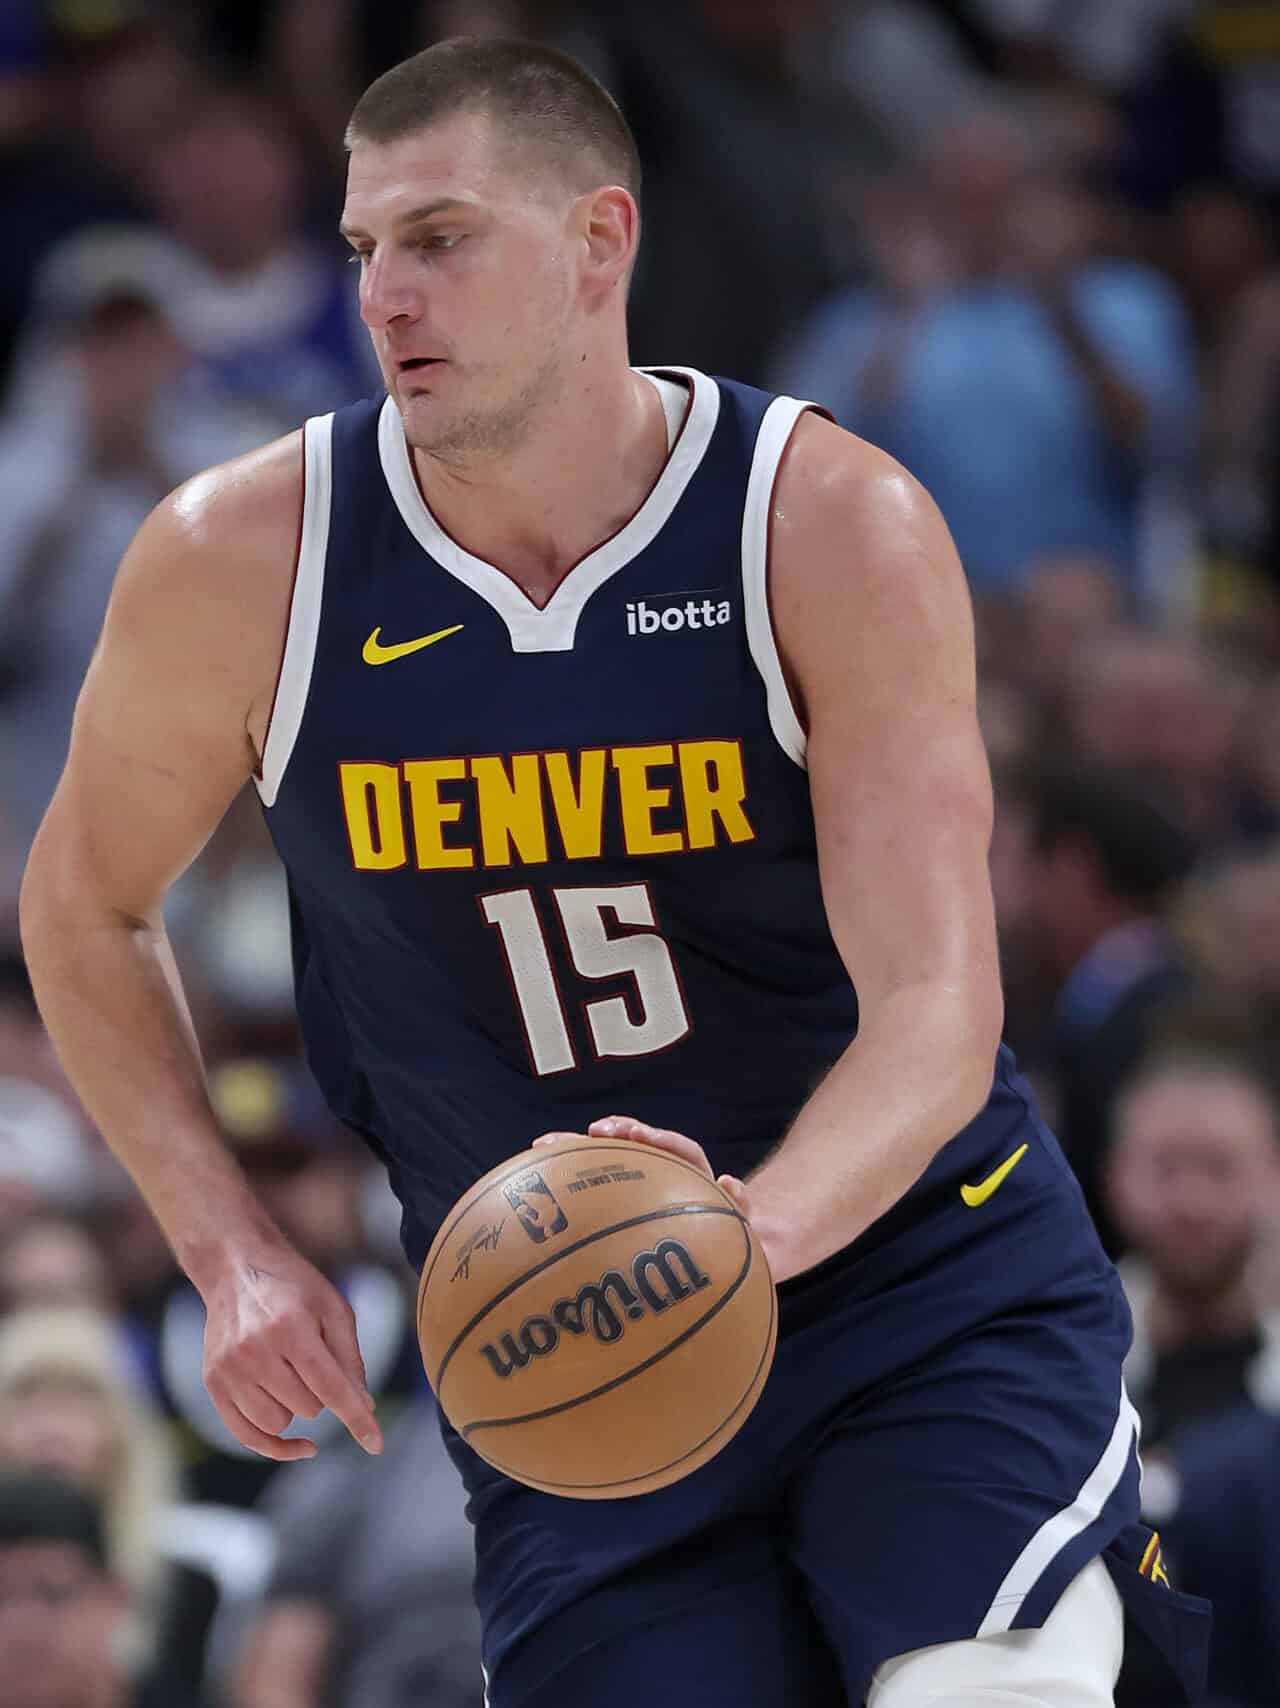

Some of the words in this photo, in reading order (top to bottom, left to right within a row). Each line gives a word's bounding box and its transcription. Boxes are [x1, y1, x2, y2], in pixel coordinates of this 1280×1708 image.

[626, 600, 730, 635] ibotta
[337, 738, 756, 872] DENVER
[479, 880, 694, 1076] 15
[480, 1238, 712, 1378] Wilson
